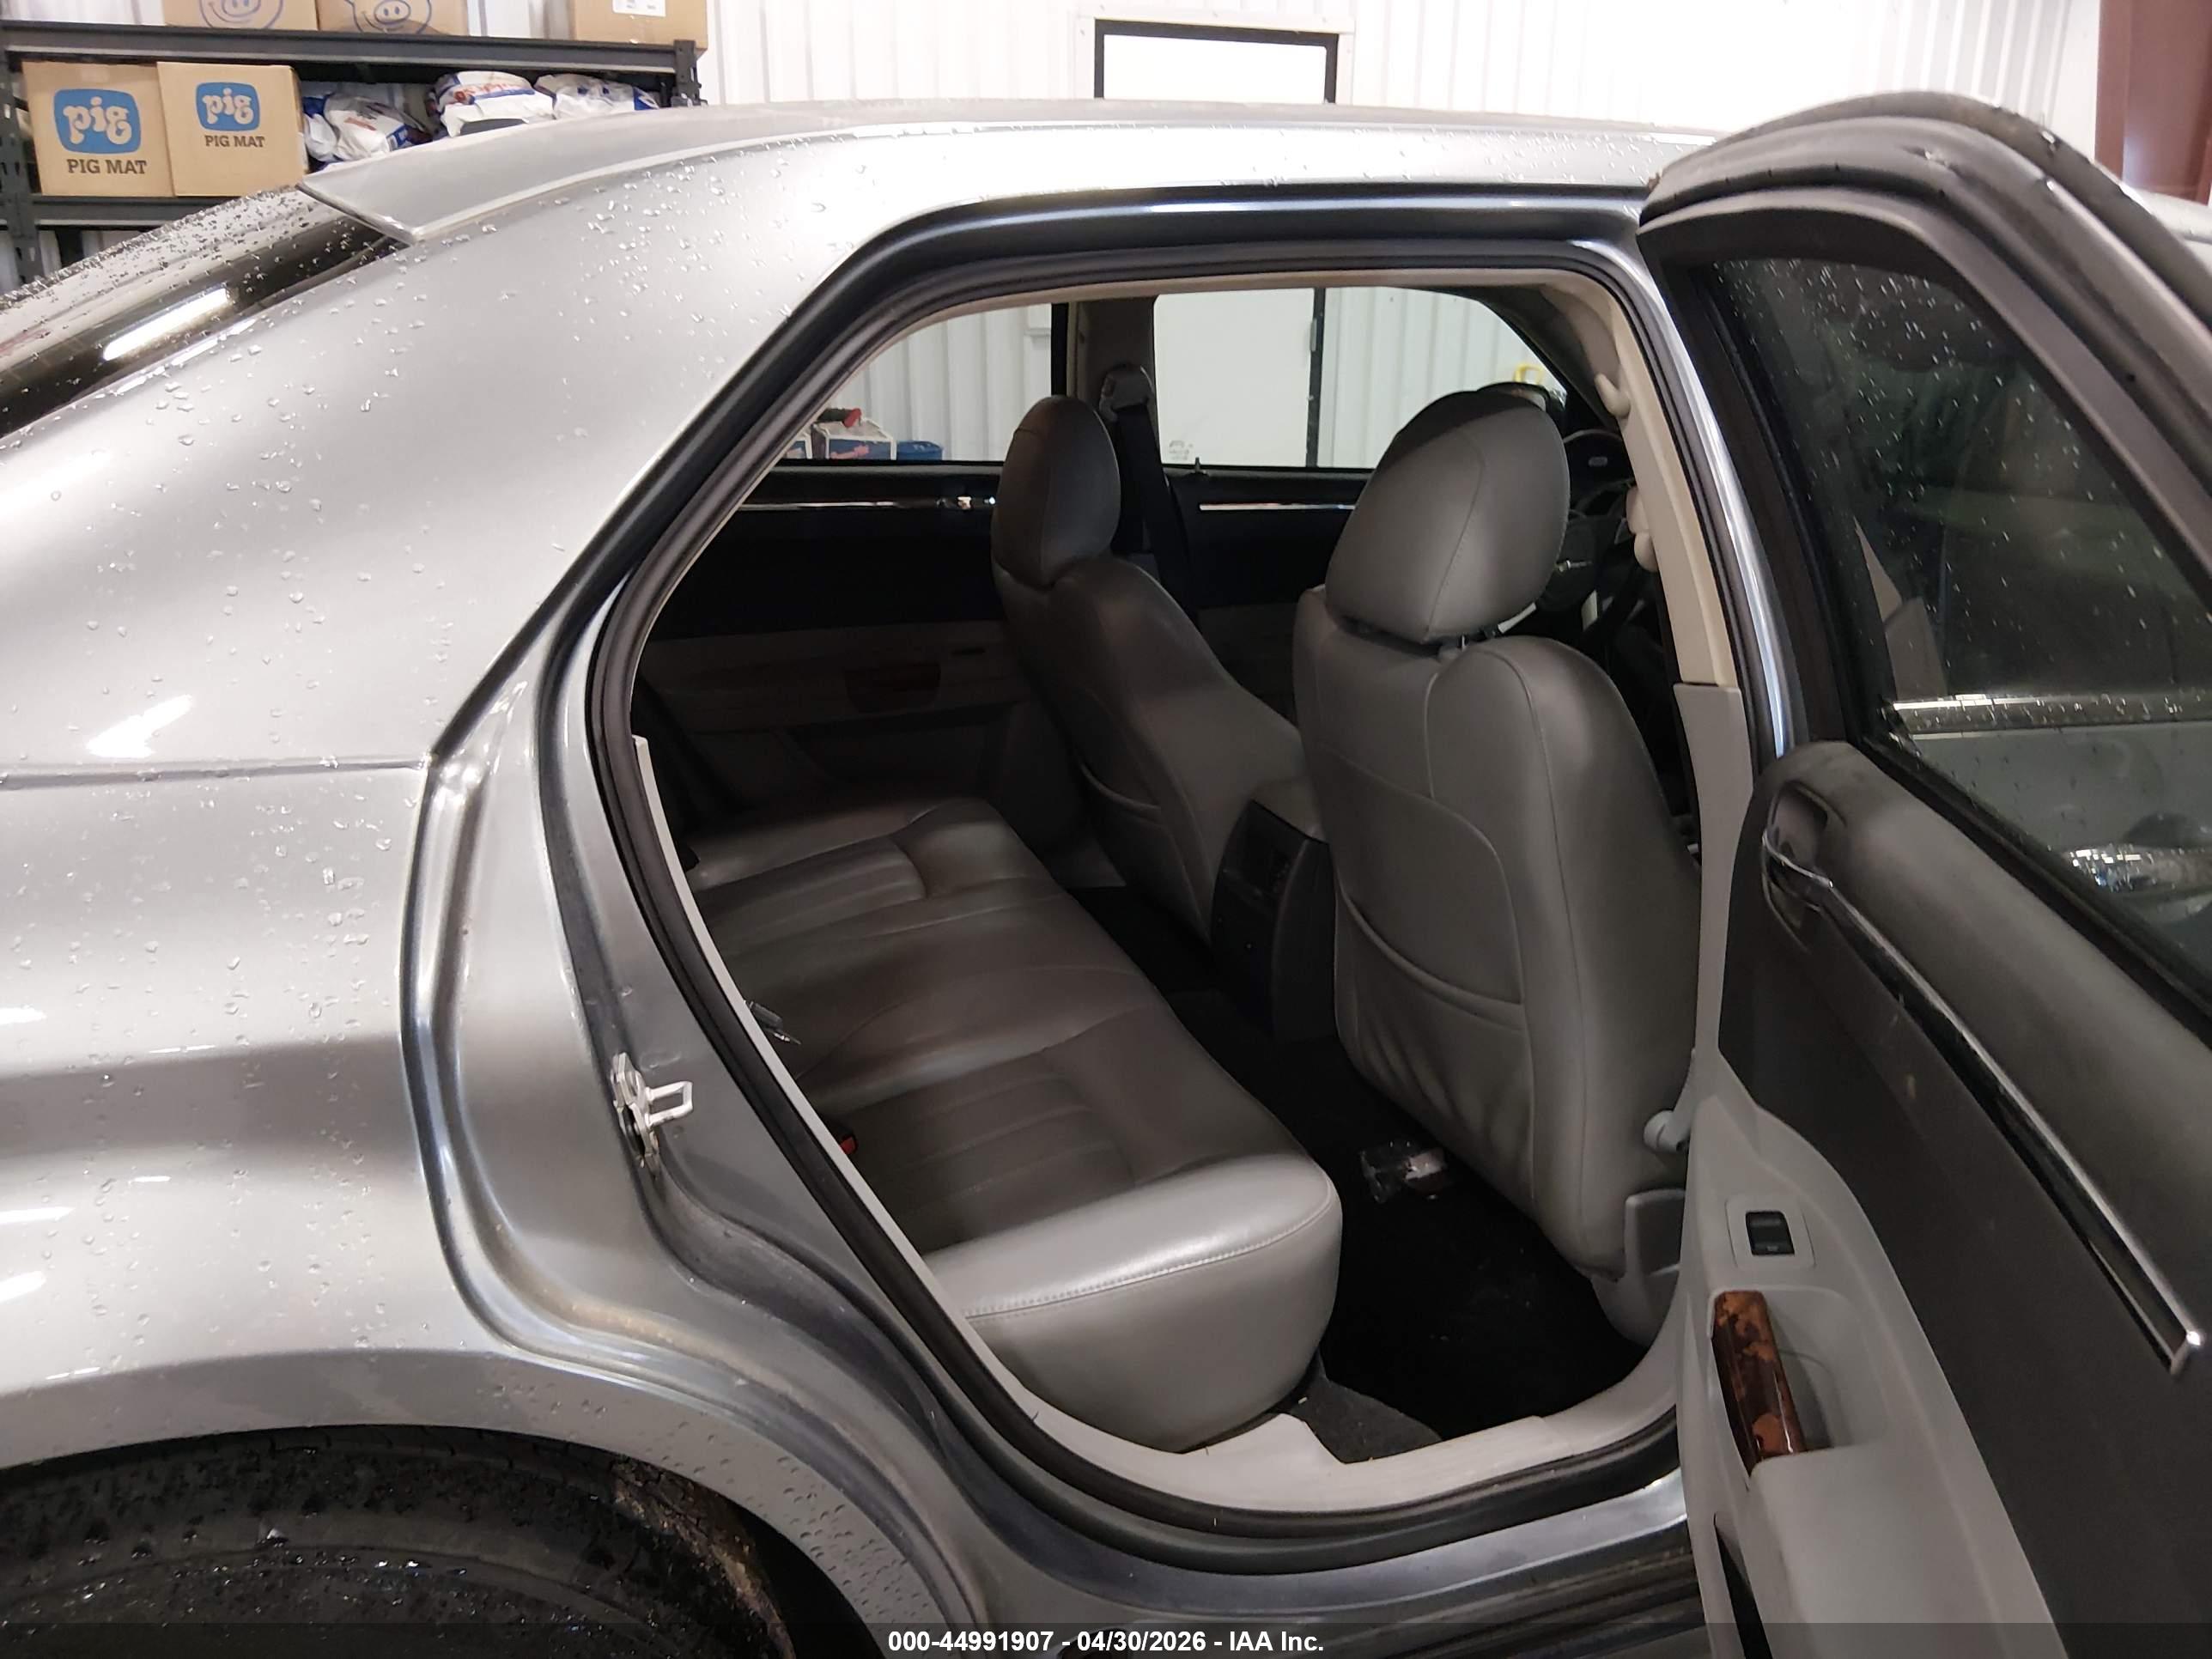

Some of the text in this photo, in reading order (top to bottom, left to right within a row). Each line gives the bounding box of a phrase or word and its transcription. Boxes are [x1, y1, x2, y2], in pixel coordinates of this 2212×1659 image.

[202, 87, 254, 125] pig
[63, 95, 132, 145] pig
[204, 135, 265, 148] PIG MAT
[67, 159, 147, 174] PIG MAT
